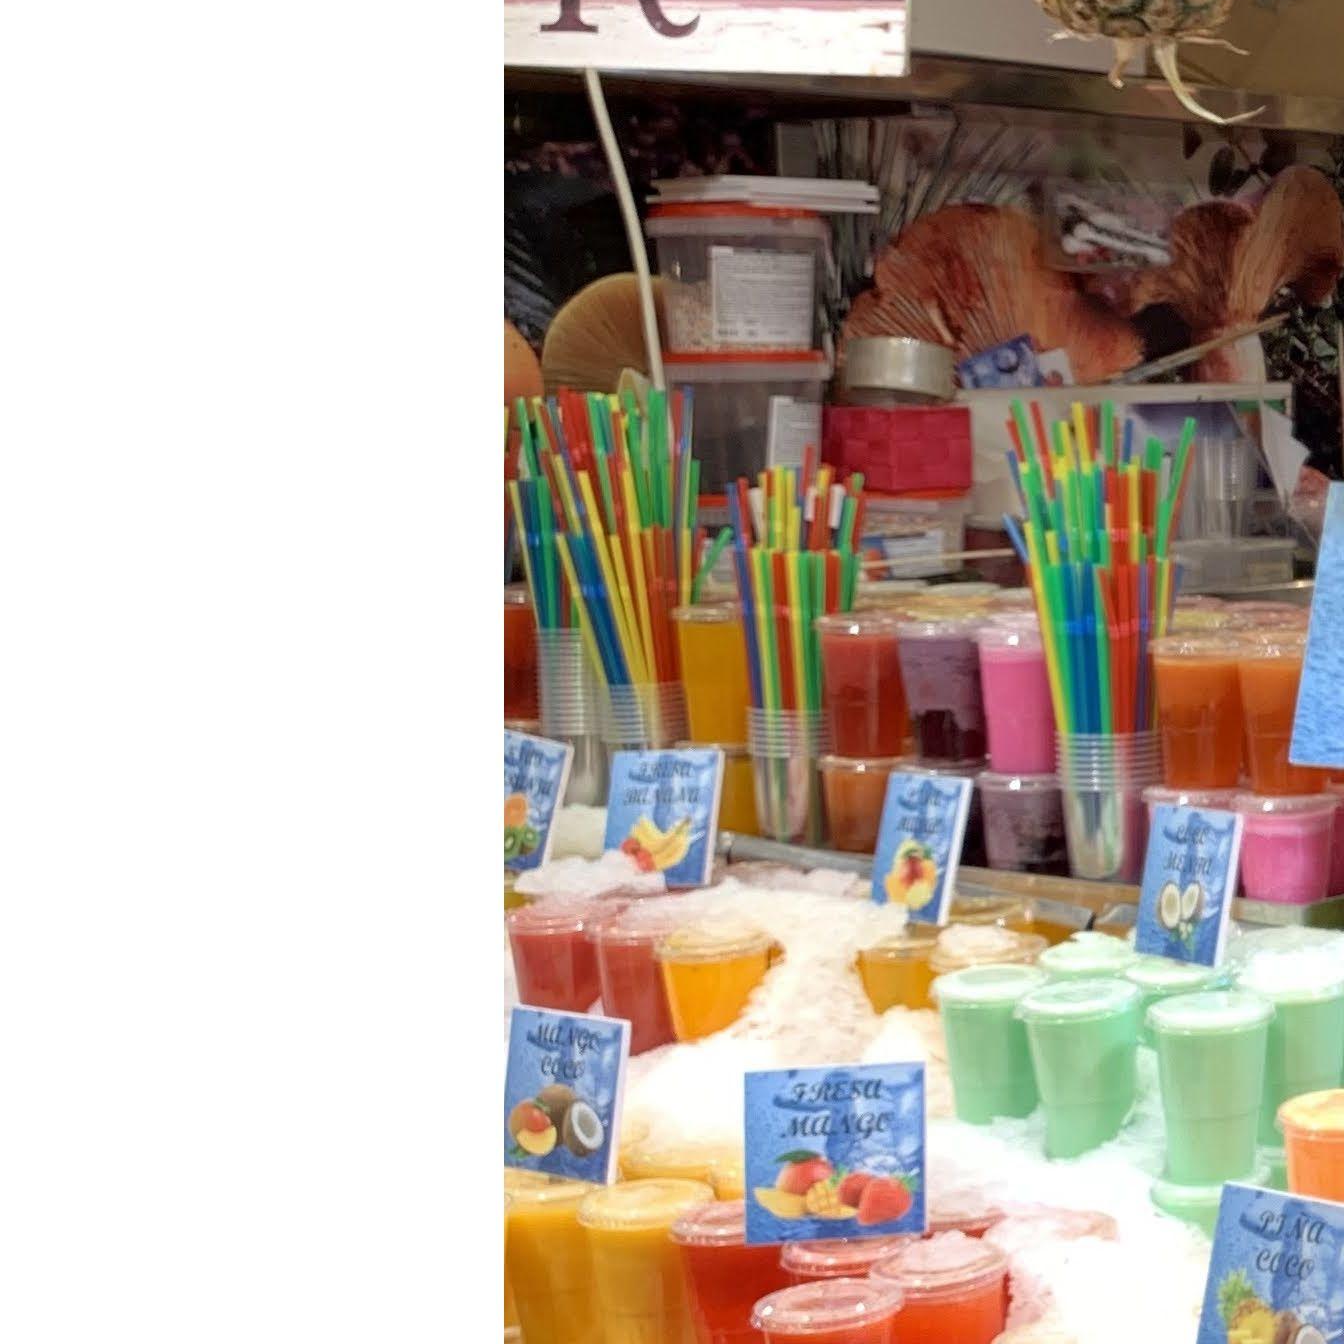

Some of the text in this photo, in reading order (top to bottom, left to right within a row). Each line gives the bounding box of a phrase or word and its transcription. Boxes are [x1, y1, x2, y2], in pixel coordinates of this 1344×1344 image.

[532, 1023, 603, 1055] MANGO
[541, 1055, 585, 1079] COCO
[790, 1078, 885, 1104] FRESA
[780, 1110, 895, 1138] MANGO
[1256, 1248, 1315, 1280] COCO
